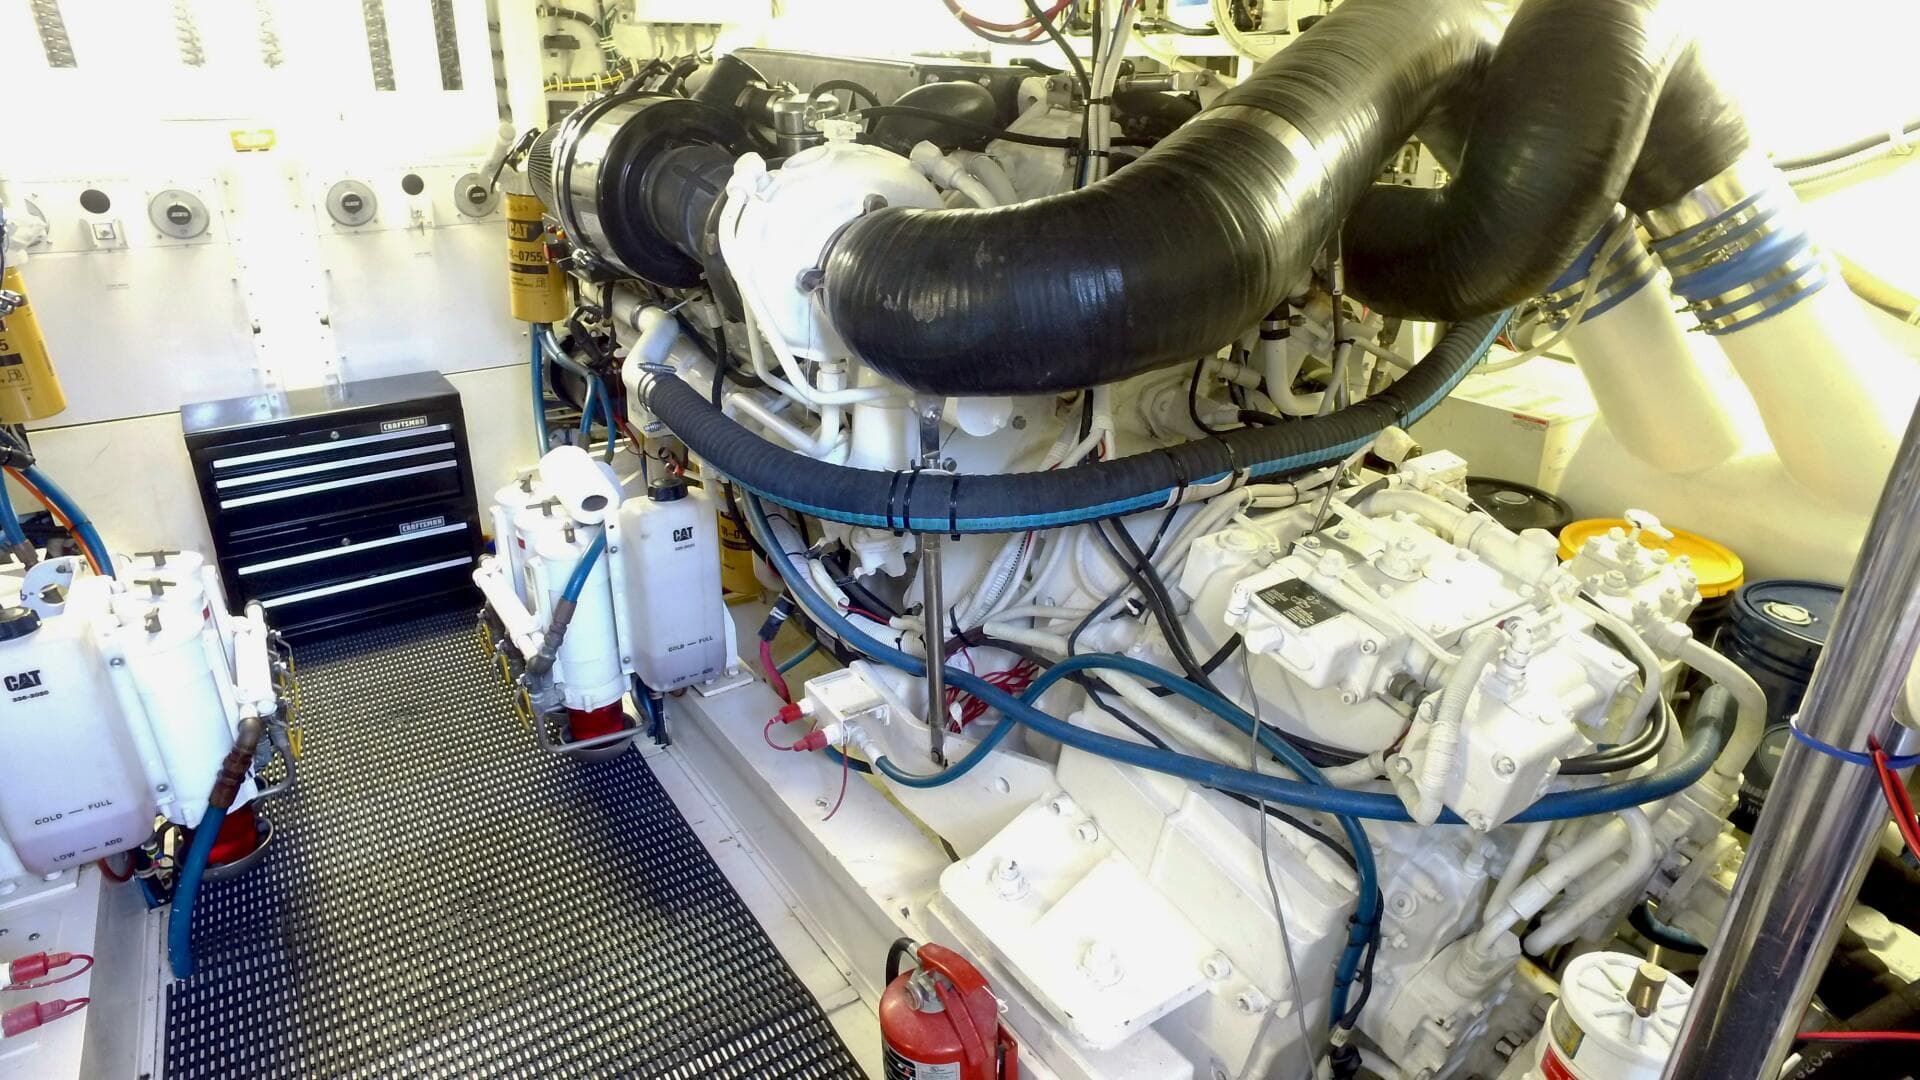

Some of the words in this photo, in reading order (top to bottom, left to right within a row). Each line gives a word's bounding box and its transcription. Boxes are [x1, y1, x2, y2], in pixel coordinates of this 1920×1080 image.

[383, 418, 425, 430] CRAFTSMAN
[673, 526, 693, 542] CAT
[698, 635, 713, 644] FULL
[3, 669, 42, 692] CAT
[34, 813, 63, 825] COLD
[87, 799, 113, 811] FULL
[53, 851, 76, 862] LOW
[104, 837, 123, 848] ADD
